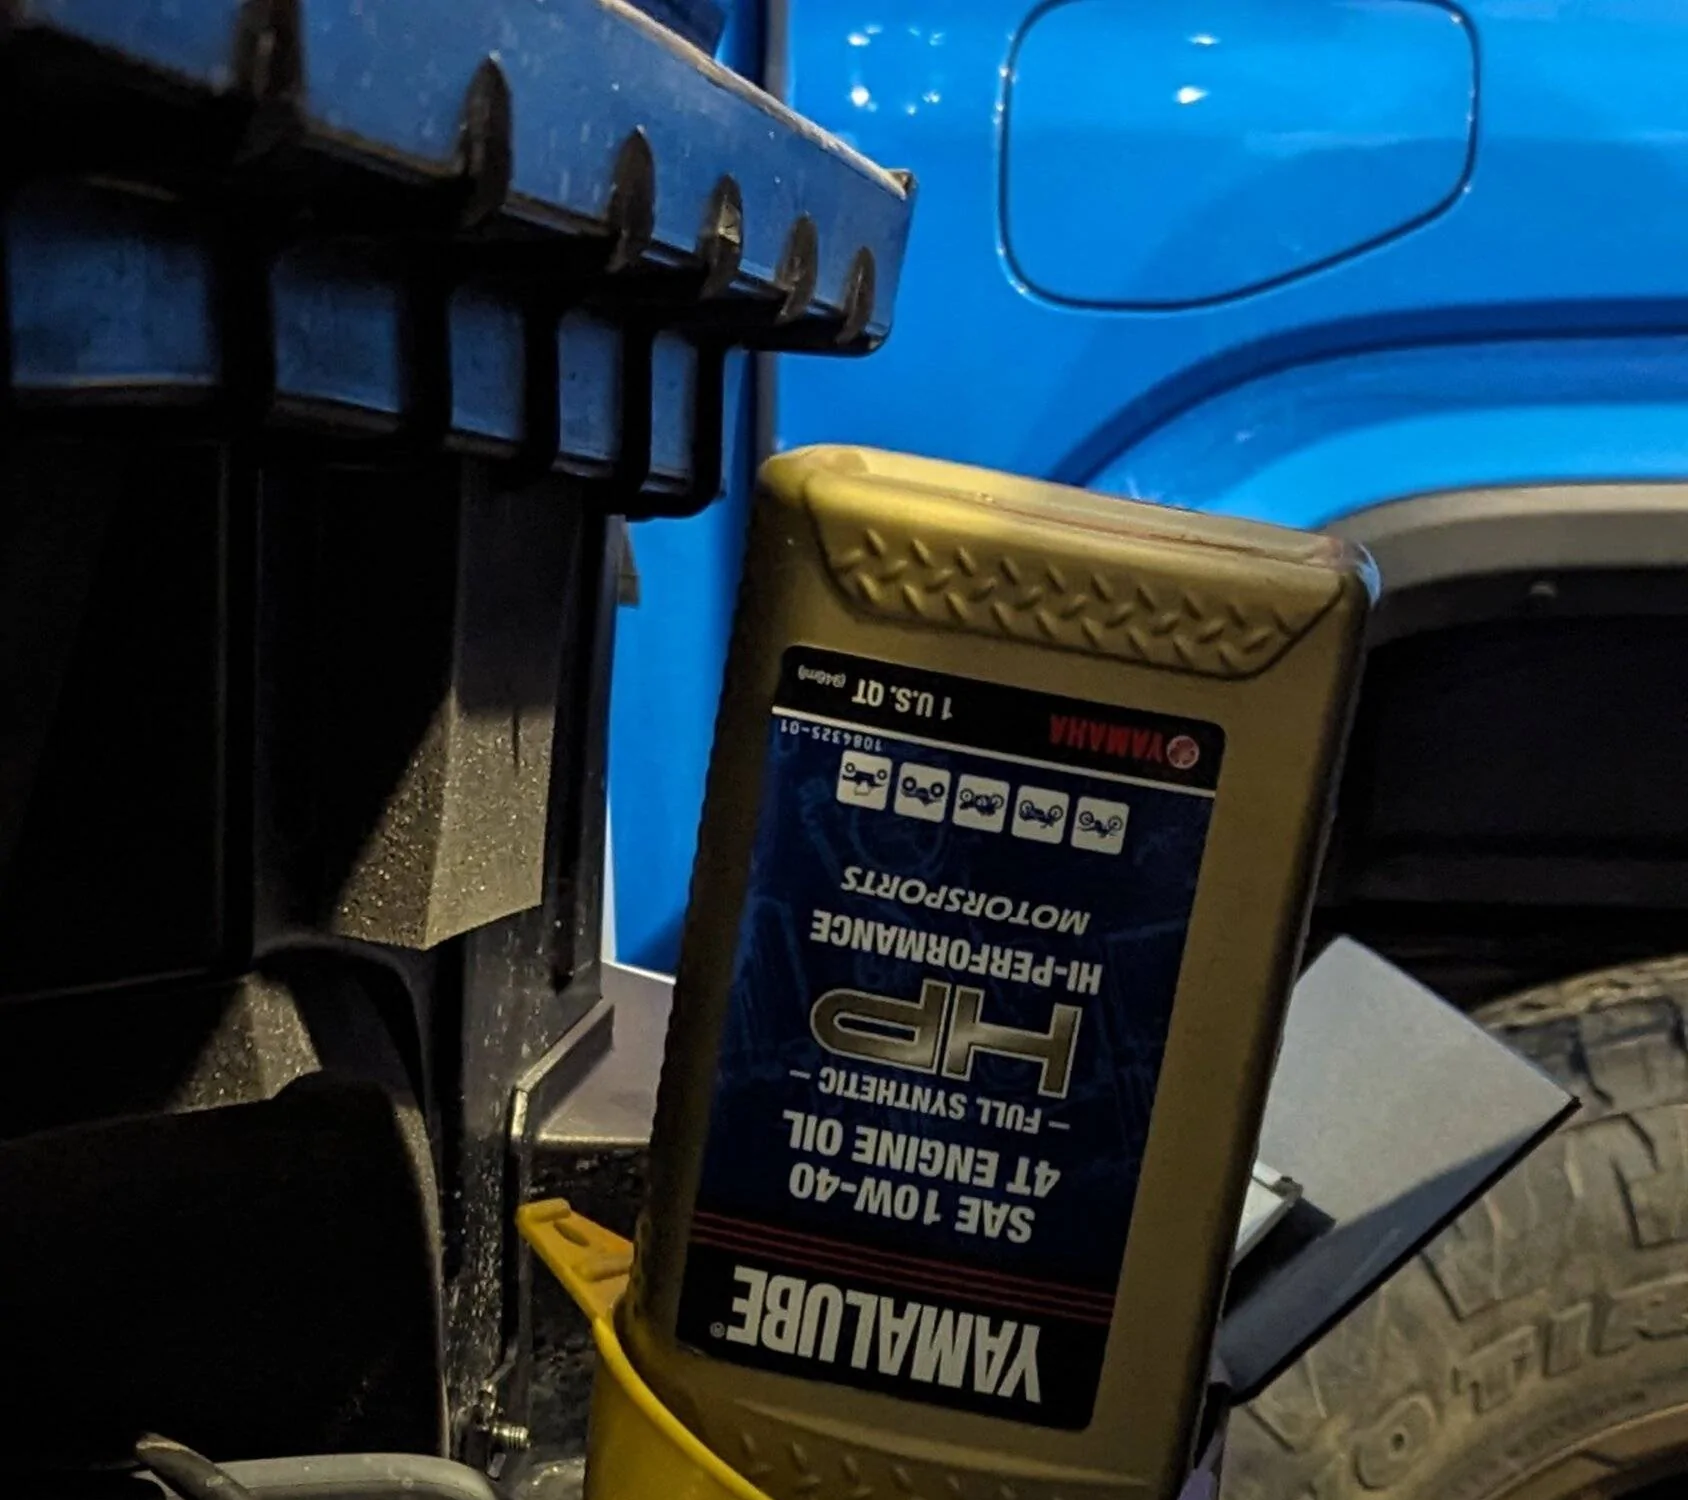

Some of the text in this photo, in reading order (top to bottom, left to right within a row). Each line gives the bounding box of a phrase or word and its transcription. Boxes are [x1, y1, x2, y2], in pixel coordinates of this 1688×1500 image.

[851, 677, 954, 721] 1 U.S. QT
[1048, 713, 1165, 764] YAMAHA
[840, 865, 1092, 936] MOTORSPORTS
[809, 909, 1104, 996] HI-PERFORMANCE
[810, 978, 1083, 1099] HP
[818, 1066, 1043, 1135] FULL SYNTHETIC
[782, 1109, 1062, 1198] 4T ENGINE OIL
[788, 1162, 1036, 1243] SAE 10W-40
